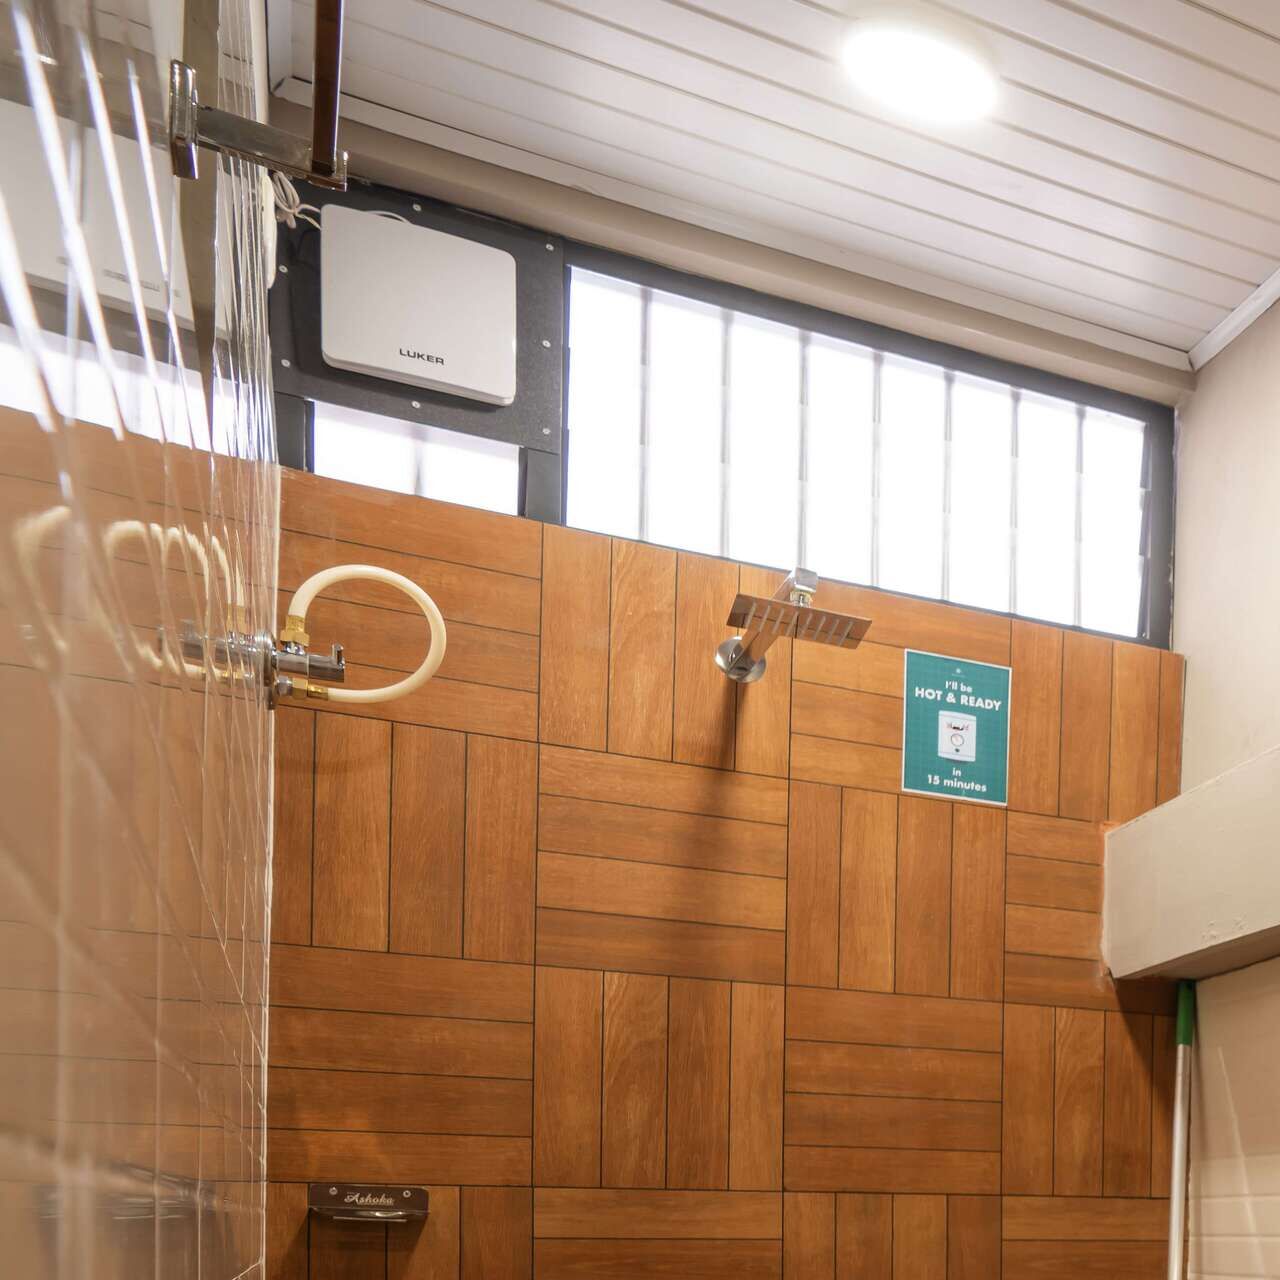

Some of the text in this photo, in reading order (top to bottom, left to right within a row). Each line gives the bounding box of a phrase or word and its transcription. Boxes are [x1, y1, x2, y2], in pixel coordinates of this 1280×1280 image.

[399, 347, 445, 366] LUKER
[945, 680, 973, 693] I'll be
[914, 686, 1002, 711] HOT & READY
[952, 767, 962, 776] in
[927, 774, 987, 792] 15 minutes
[343, 1192, 395, 1204] Ashoka
